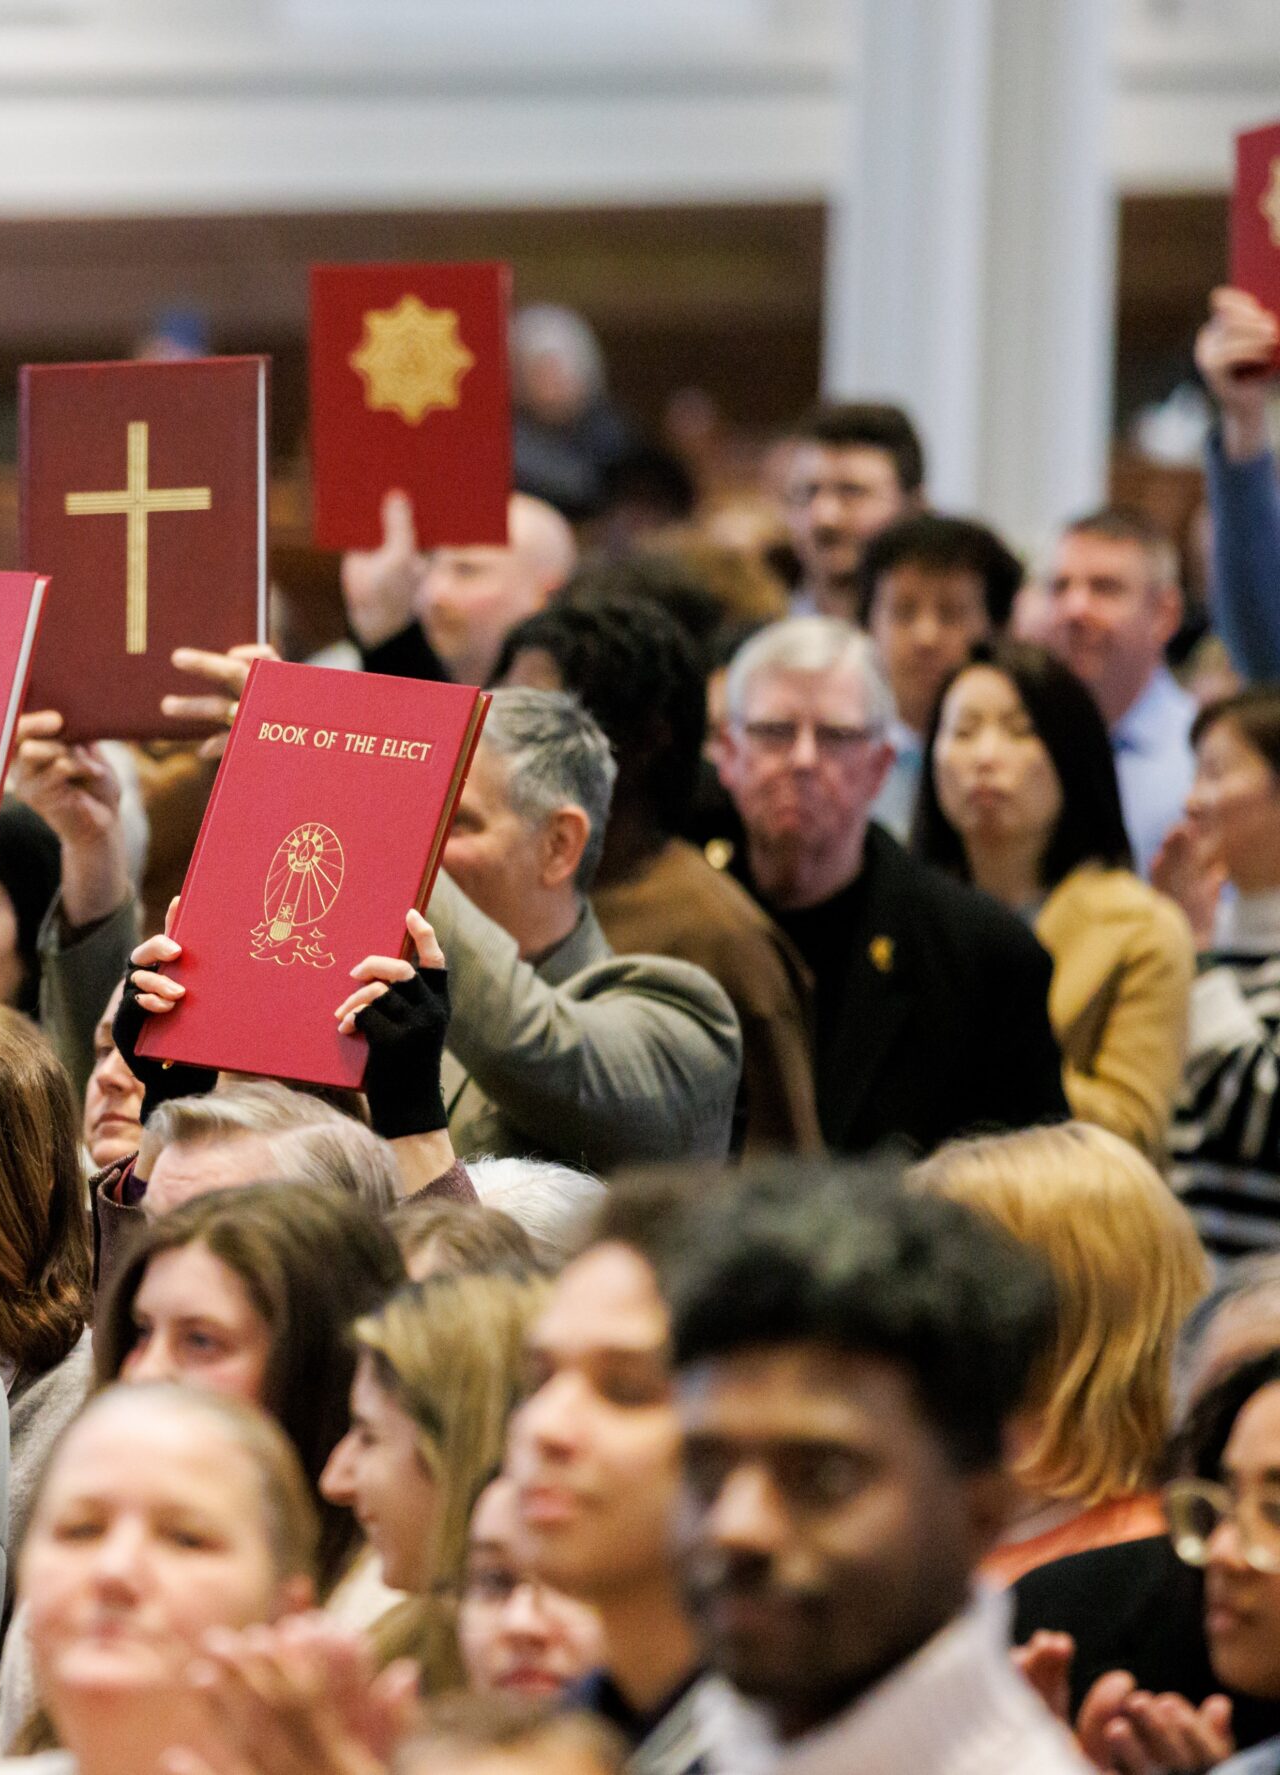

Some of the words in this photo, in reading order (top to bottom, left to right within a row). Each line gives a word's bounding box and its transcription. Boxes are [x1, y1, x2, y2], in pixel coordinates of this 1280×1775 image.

[258, 722, 309, 746] BOOK
[313, 730, 339, 750] OF
[344, 733, 377, 755] THE
[380, 738, 432, 762] ELECT
